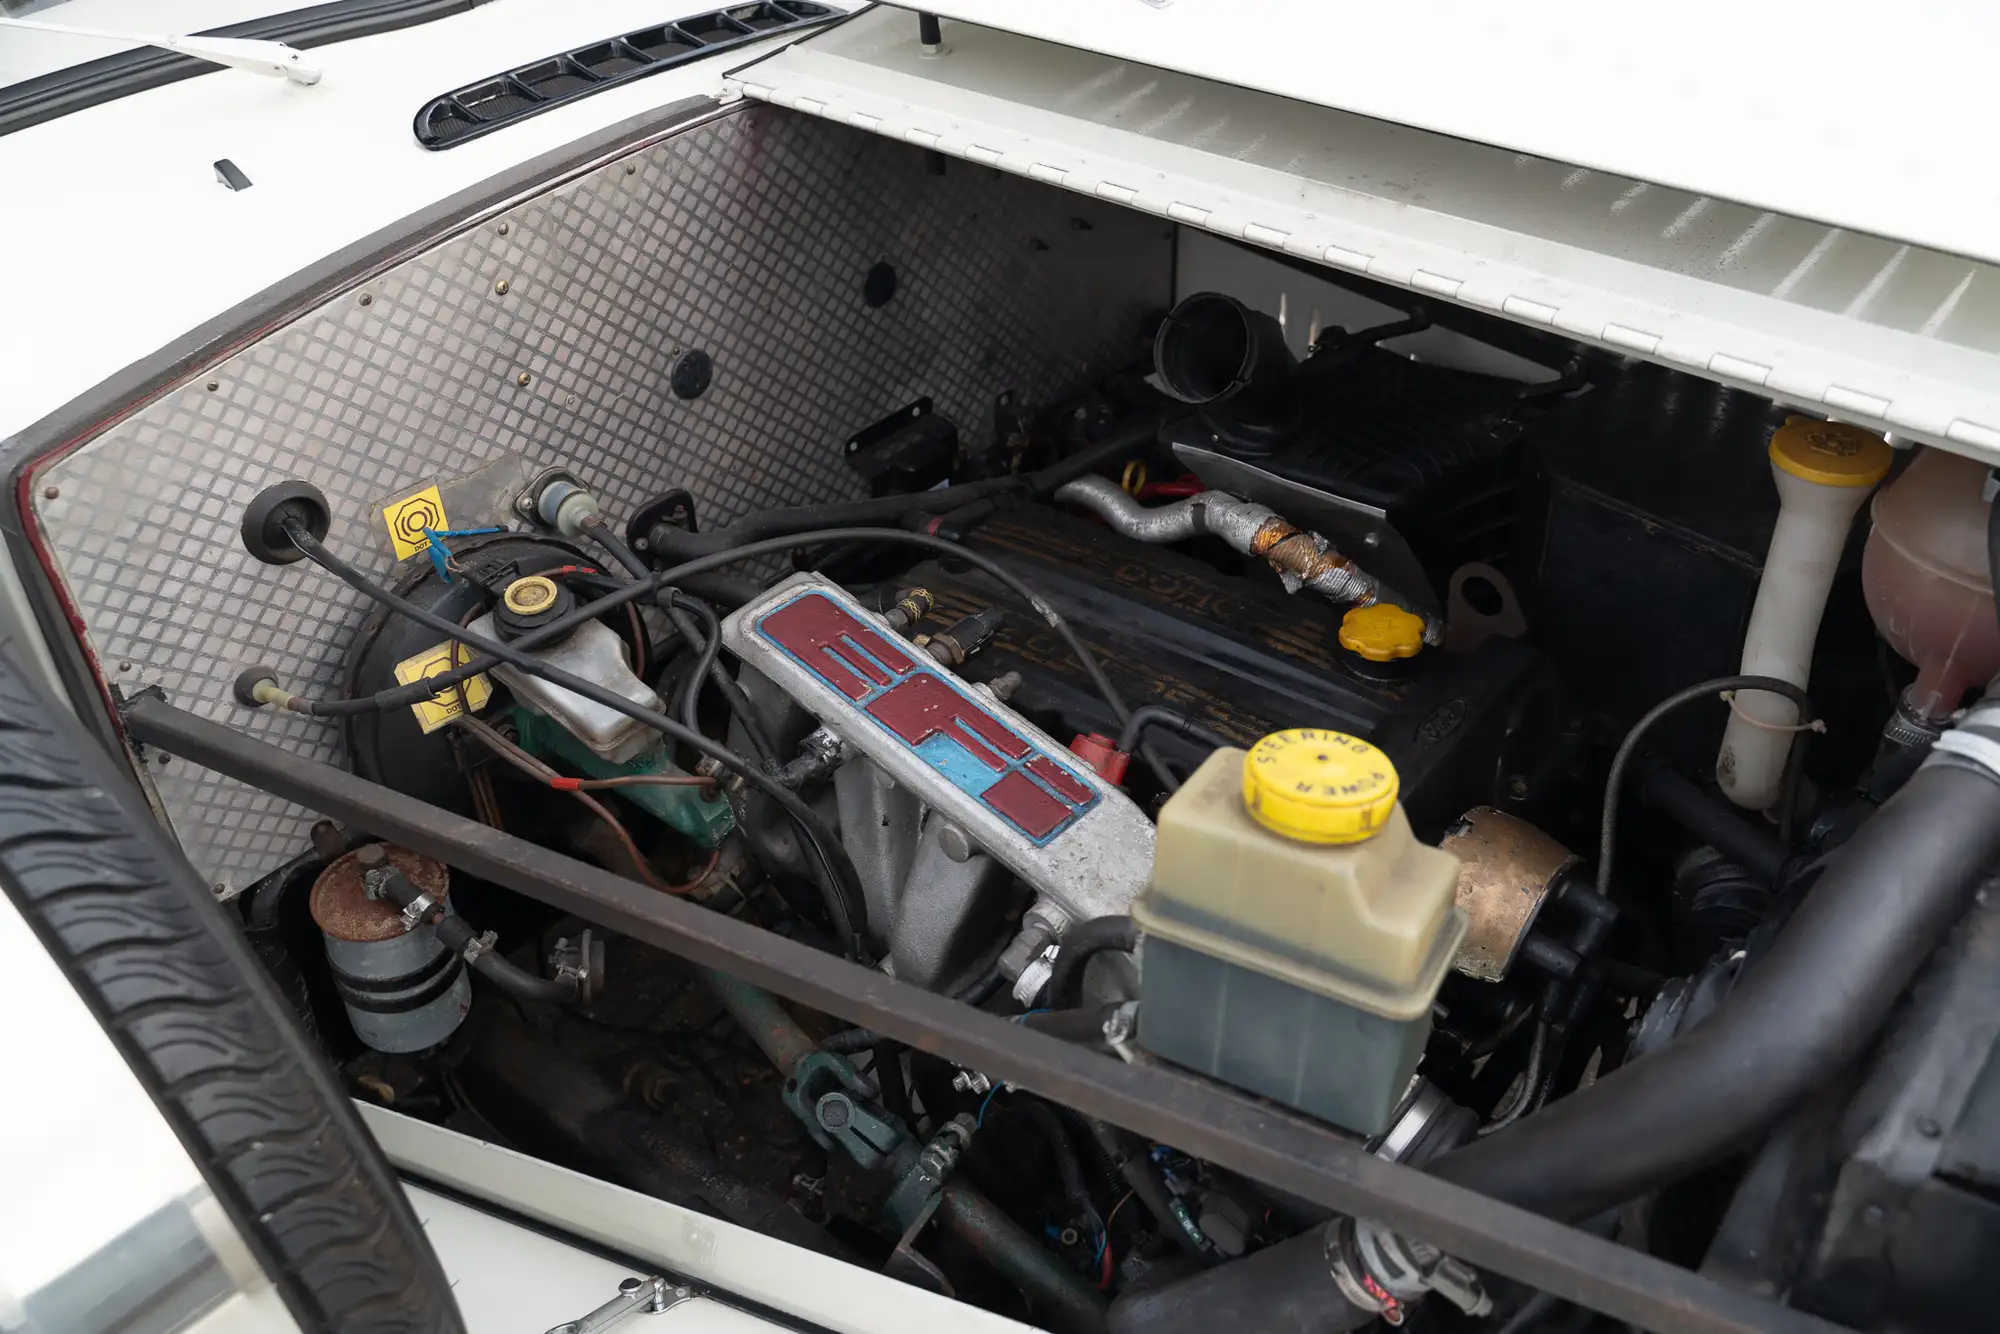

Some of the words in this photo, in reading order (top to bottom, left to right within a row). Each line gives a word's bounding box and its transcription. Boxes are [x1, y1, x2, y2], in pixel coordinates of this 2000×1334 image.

[414, 540, 429, 552] DOT
[1256, 729, 1370, 764] STEERING
[1296, 769, 1386, 796] POWER
